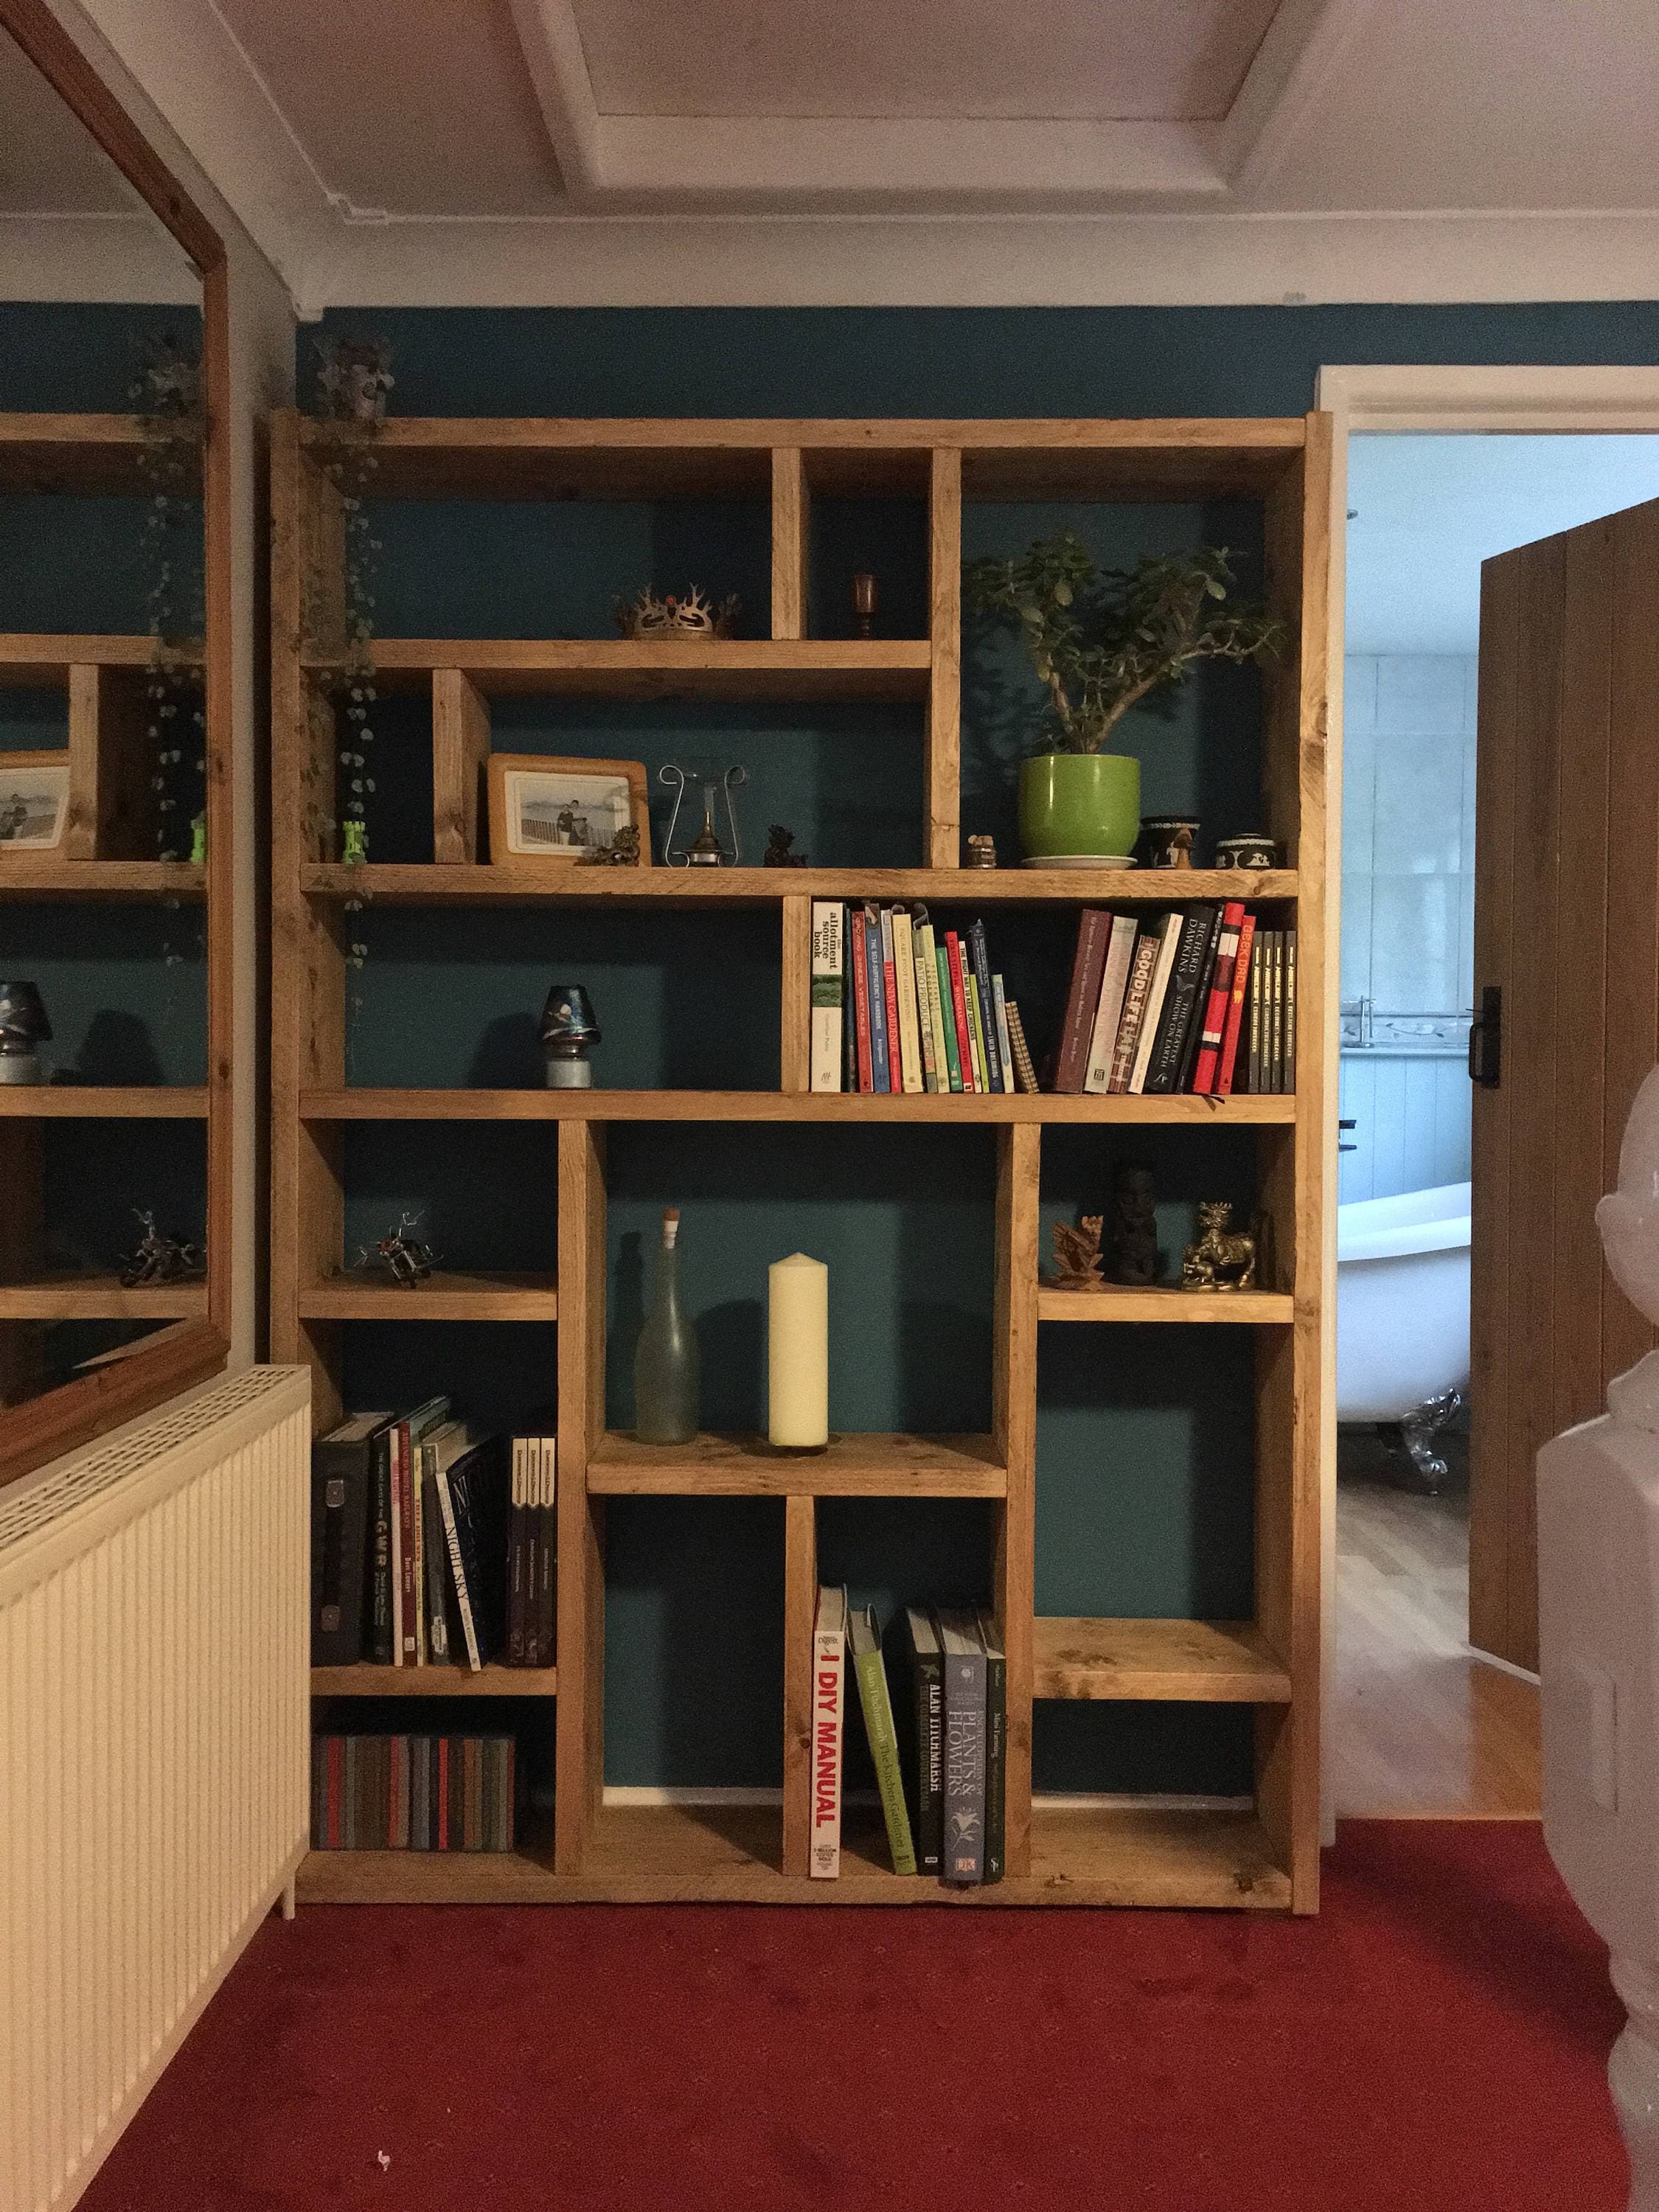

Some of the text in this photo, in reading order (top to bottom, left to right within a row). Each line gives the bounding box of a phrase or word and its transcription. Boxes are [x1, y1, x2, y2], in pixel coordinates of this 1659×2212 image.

[813, 931, 822, 958] book
[829, 912, 838, 969] allotment
[1178, 918, 1198, 973] DAWKINS
[1188, 922, 1206, 973] RICHARD
[1236, 924, 1252, 984] GEEK DAD
[885, 964, 893, 981] THE
[886, 983, 894, 1004] NEW
[917, 959, 929, 1027] PATIO PRODUCE
[1133, 948, 1152, 990] GOOD
[858, 987, 866, 1037] VEGETABLES
[888, 1005, 898, 1053] GARDENER
[1126, 992, 1143, 1023] LIFE
[1160, 995, 1183, 1067] SHOW ON EARTH
[1169, 1001, 1189, 1065] THE GREATEST
[378, 1498, 383, 1506] OF
[445, 1525, 462, 1570] NIGHT
[454, 1573, 468, 1601] SKY
[817, 1672, 838, 1713] DIY
[866, 1666, 876, 1688] Alan
[928, 1683, 942, 1792] ALAN TITCHMARSH
[947, 1710, 962, 1796] FLOWERS
[961, 1709, 976, 1779] PLANTS
[990, 1729, 1000, 1758] Farming
[815, 1722, 837, 1828] MANUAL
[883, 1764, 898, 1801] Kitchen
[961, 1782, 975, 1795] &
[890, 1802, 906, 1848] Gardener
